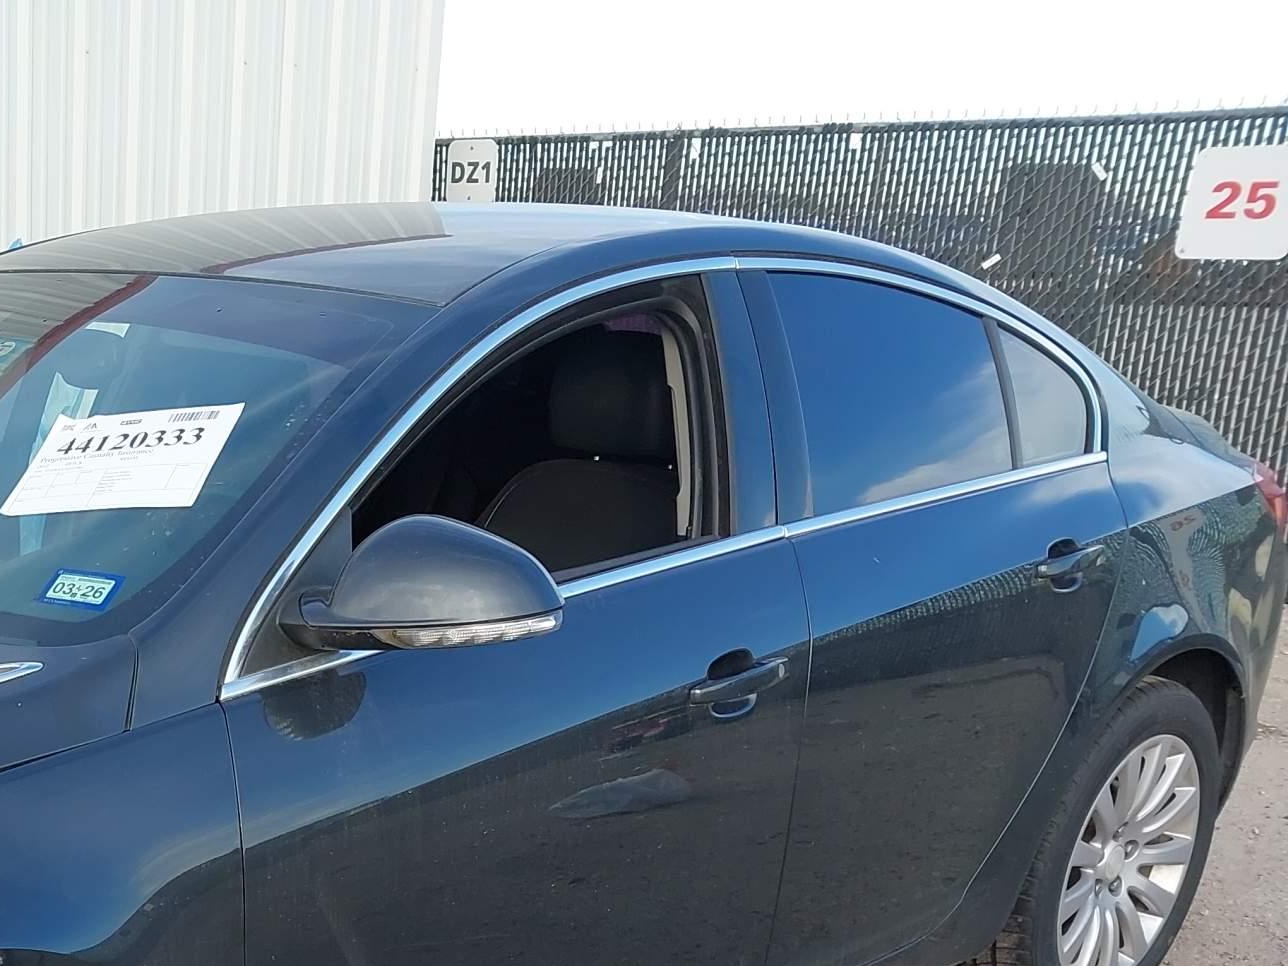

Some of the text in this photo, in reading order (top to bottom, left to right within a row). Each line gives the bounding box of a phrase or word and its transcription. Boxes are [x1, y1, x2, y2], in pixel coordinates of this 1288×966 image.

[451, 161, 491, 184] DZ1
[1204, 181, 1280, 219] 25
[56, 427, 205, 455] 44120333
[53, 582, 106, 599] 03 26
